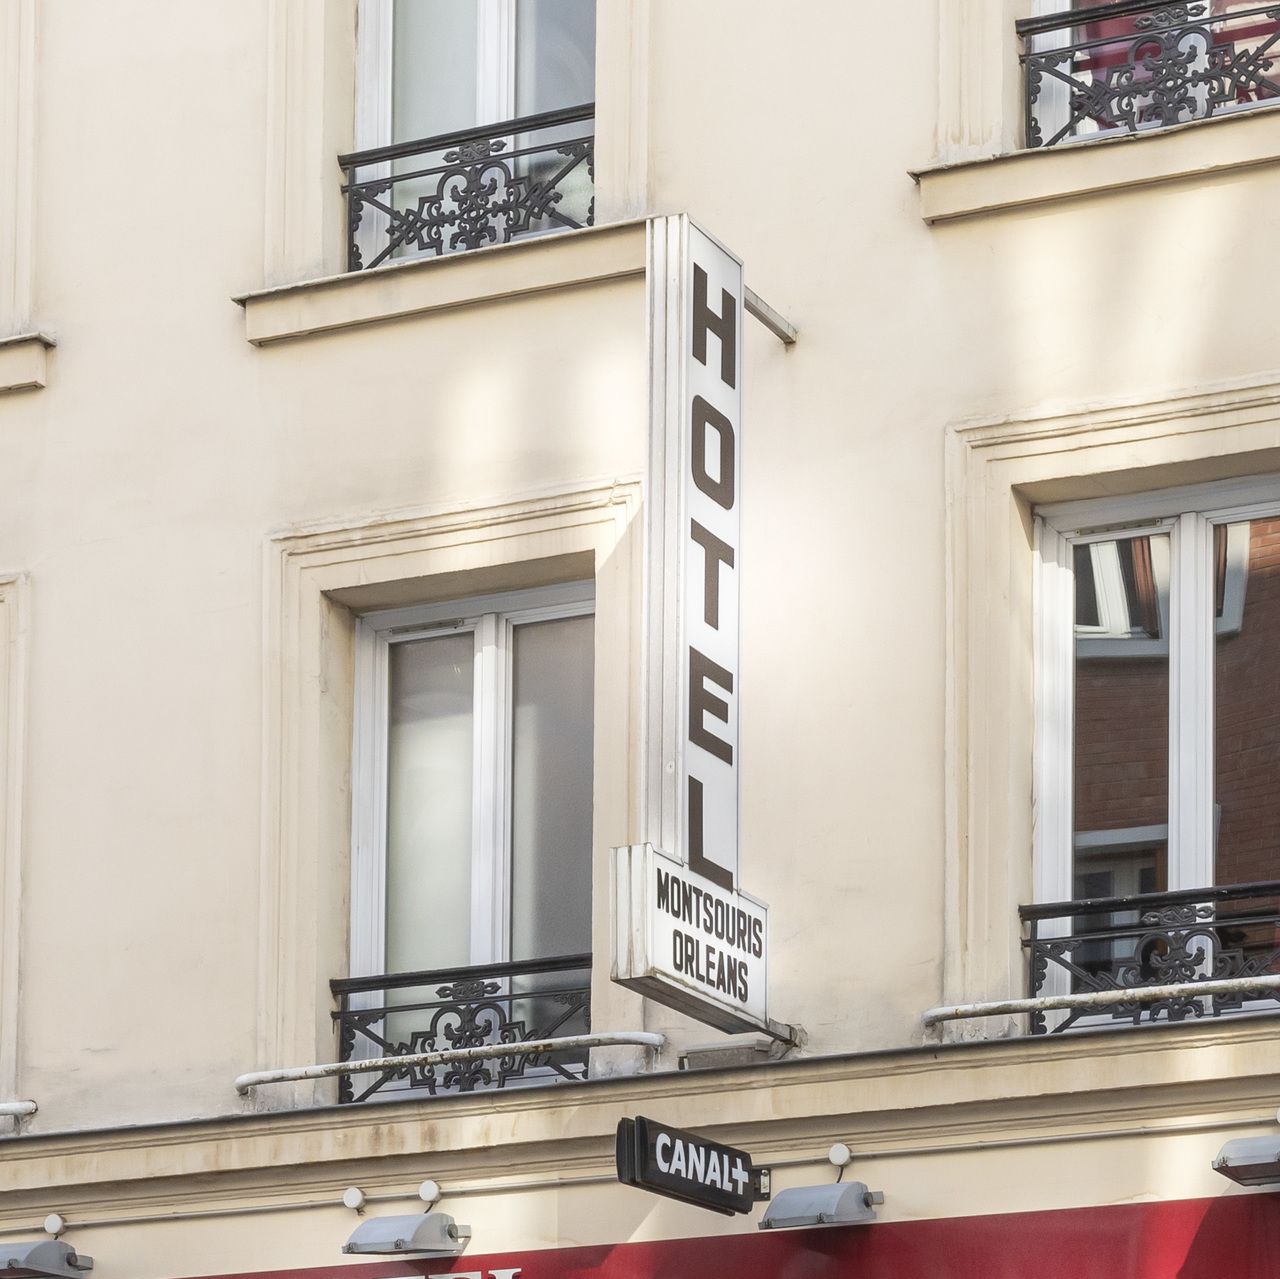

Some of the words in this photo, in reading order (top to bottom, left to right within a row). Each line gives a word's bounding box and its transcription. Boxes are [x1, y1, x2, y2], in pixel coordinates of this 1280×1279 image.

[687, 261, 737, 896] HOTEL
[656, 867, 763, 960] MONTSOURIS
[672, 928, 749, 1003] ORLEANS
[655, 1131, 750, 1196] CANAL+
